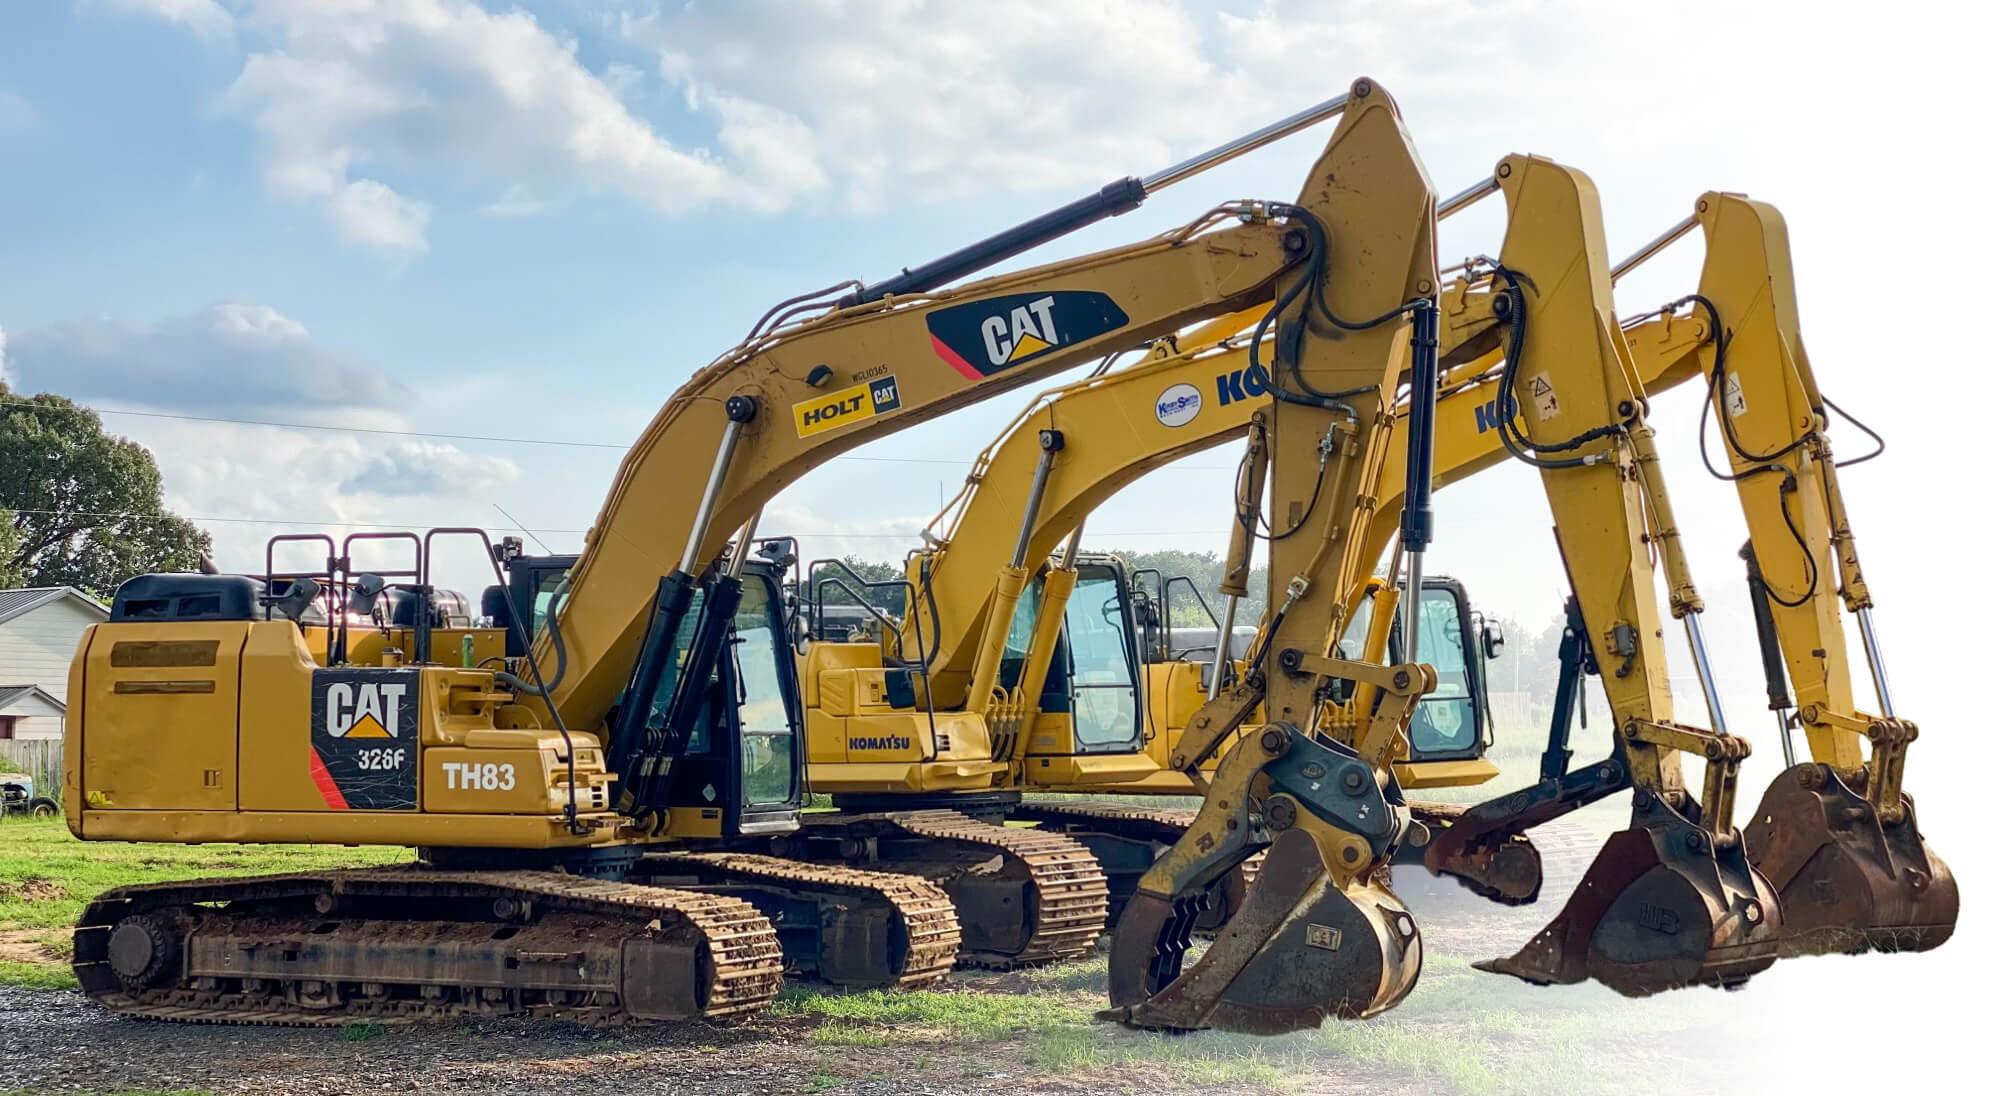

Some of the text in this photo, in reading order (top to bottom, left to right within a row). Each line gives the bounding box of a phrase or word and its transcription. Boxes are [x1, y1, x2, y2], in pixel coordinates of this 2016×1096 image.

[980, 296, 1059, 366] CAT
[803, 385, 896, 426] HOLT CAT
[327, 683, 406, 738] CAT
[849, 733, 910, 750] KOMATSU
[358, 749, 405, 770] 326F
[442, 763, 516, 791] TH83
